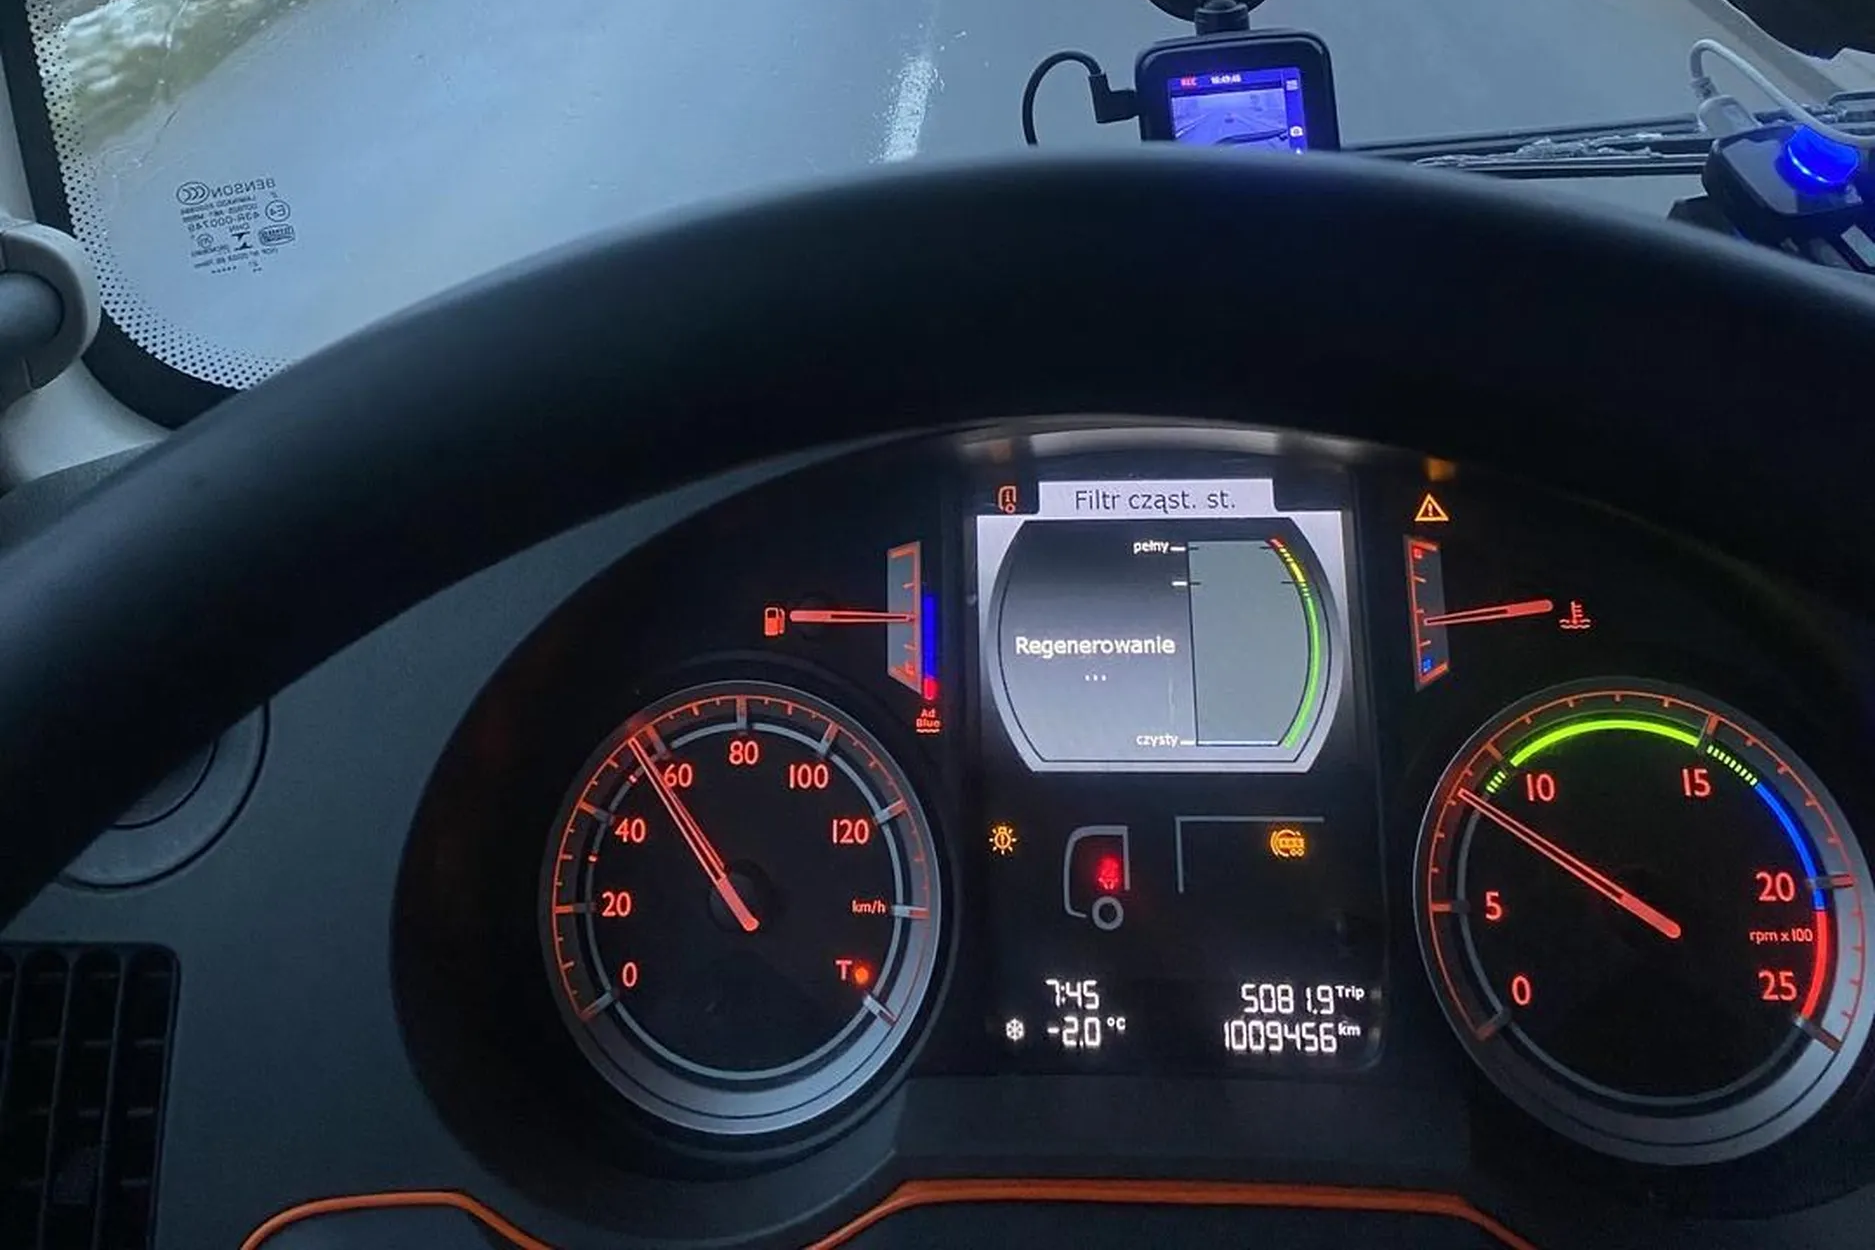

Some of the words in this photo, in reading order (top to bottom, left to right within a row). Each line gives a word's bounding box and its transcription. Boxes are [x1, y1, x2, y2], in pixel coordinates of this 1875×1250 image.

[1074, 490, 1120, 510] Filtr
[1128, 492, 1196, 515] cząst.
[1206, 491, 1236, 510] st.
[1015, 635, 1176, 659] Regenerowanie
[916, 718, 941, 728] Blue
[921, 708, 936, 718] Ad
[1136, 733, 1179, 747] czysty
[728, 741, 759, 765] 80
[664, 763, 693, 788] 60
[788, 764, 829, 789] 100
[1525, 773, 1556, 802] 10
[1681, 768, 1712, 797] 15
[615, 818, 646, 843] 40
[832, 819, 869, 844] 120
[1756, 872, 1795, 902] 20
[602, 892, 632, 918] 20
[852, 899, 886, 914] km/h
[1485, 892, 1503, 920] 5
[1749, 930, 1779, 944] rpm
[1792, 928, 1813, 943] 100
[621, 962, 638, 987] 0
[836, 960, 852, 981] T
[1045, 978, 1100, 1010] 7:45
[1335, 985, 1365, 1001] Trip
[1512, 974, 1531, 1005] 0
[1758, 971, 1798, 1002] 25
[1047, 1016, 1102, 1048] -2.0
[1223, 1019, 1338, 1053] 1009456
[1338, 1023, 1362, 1038] km
